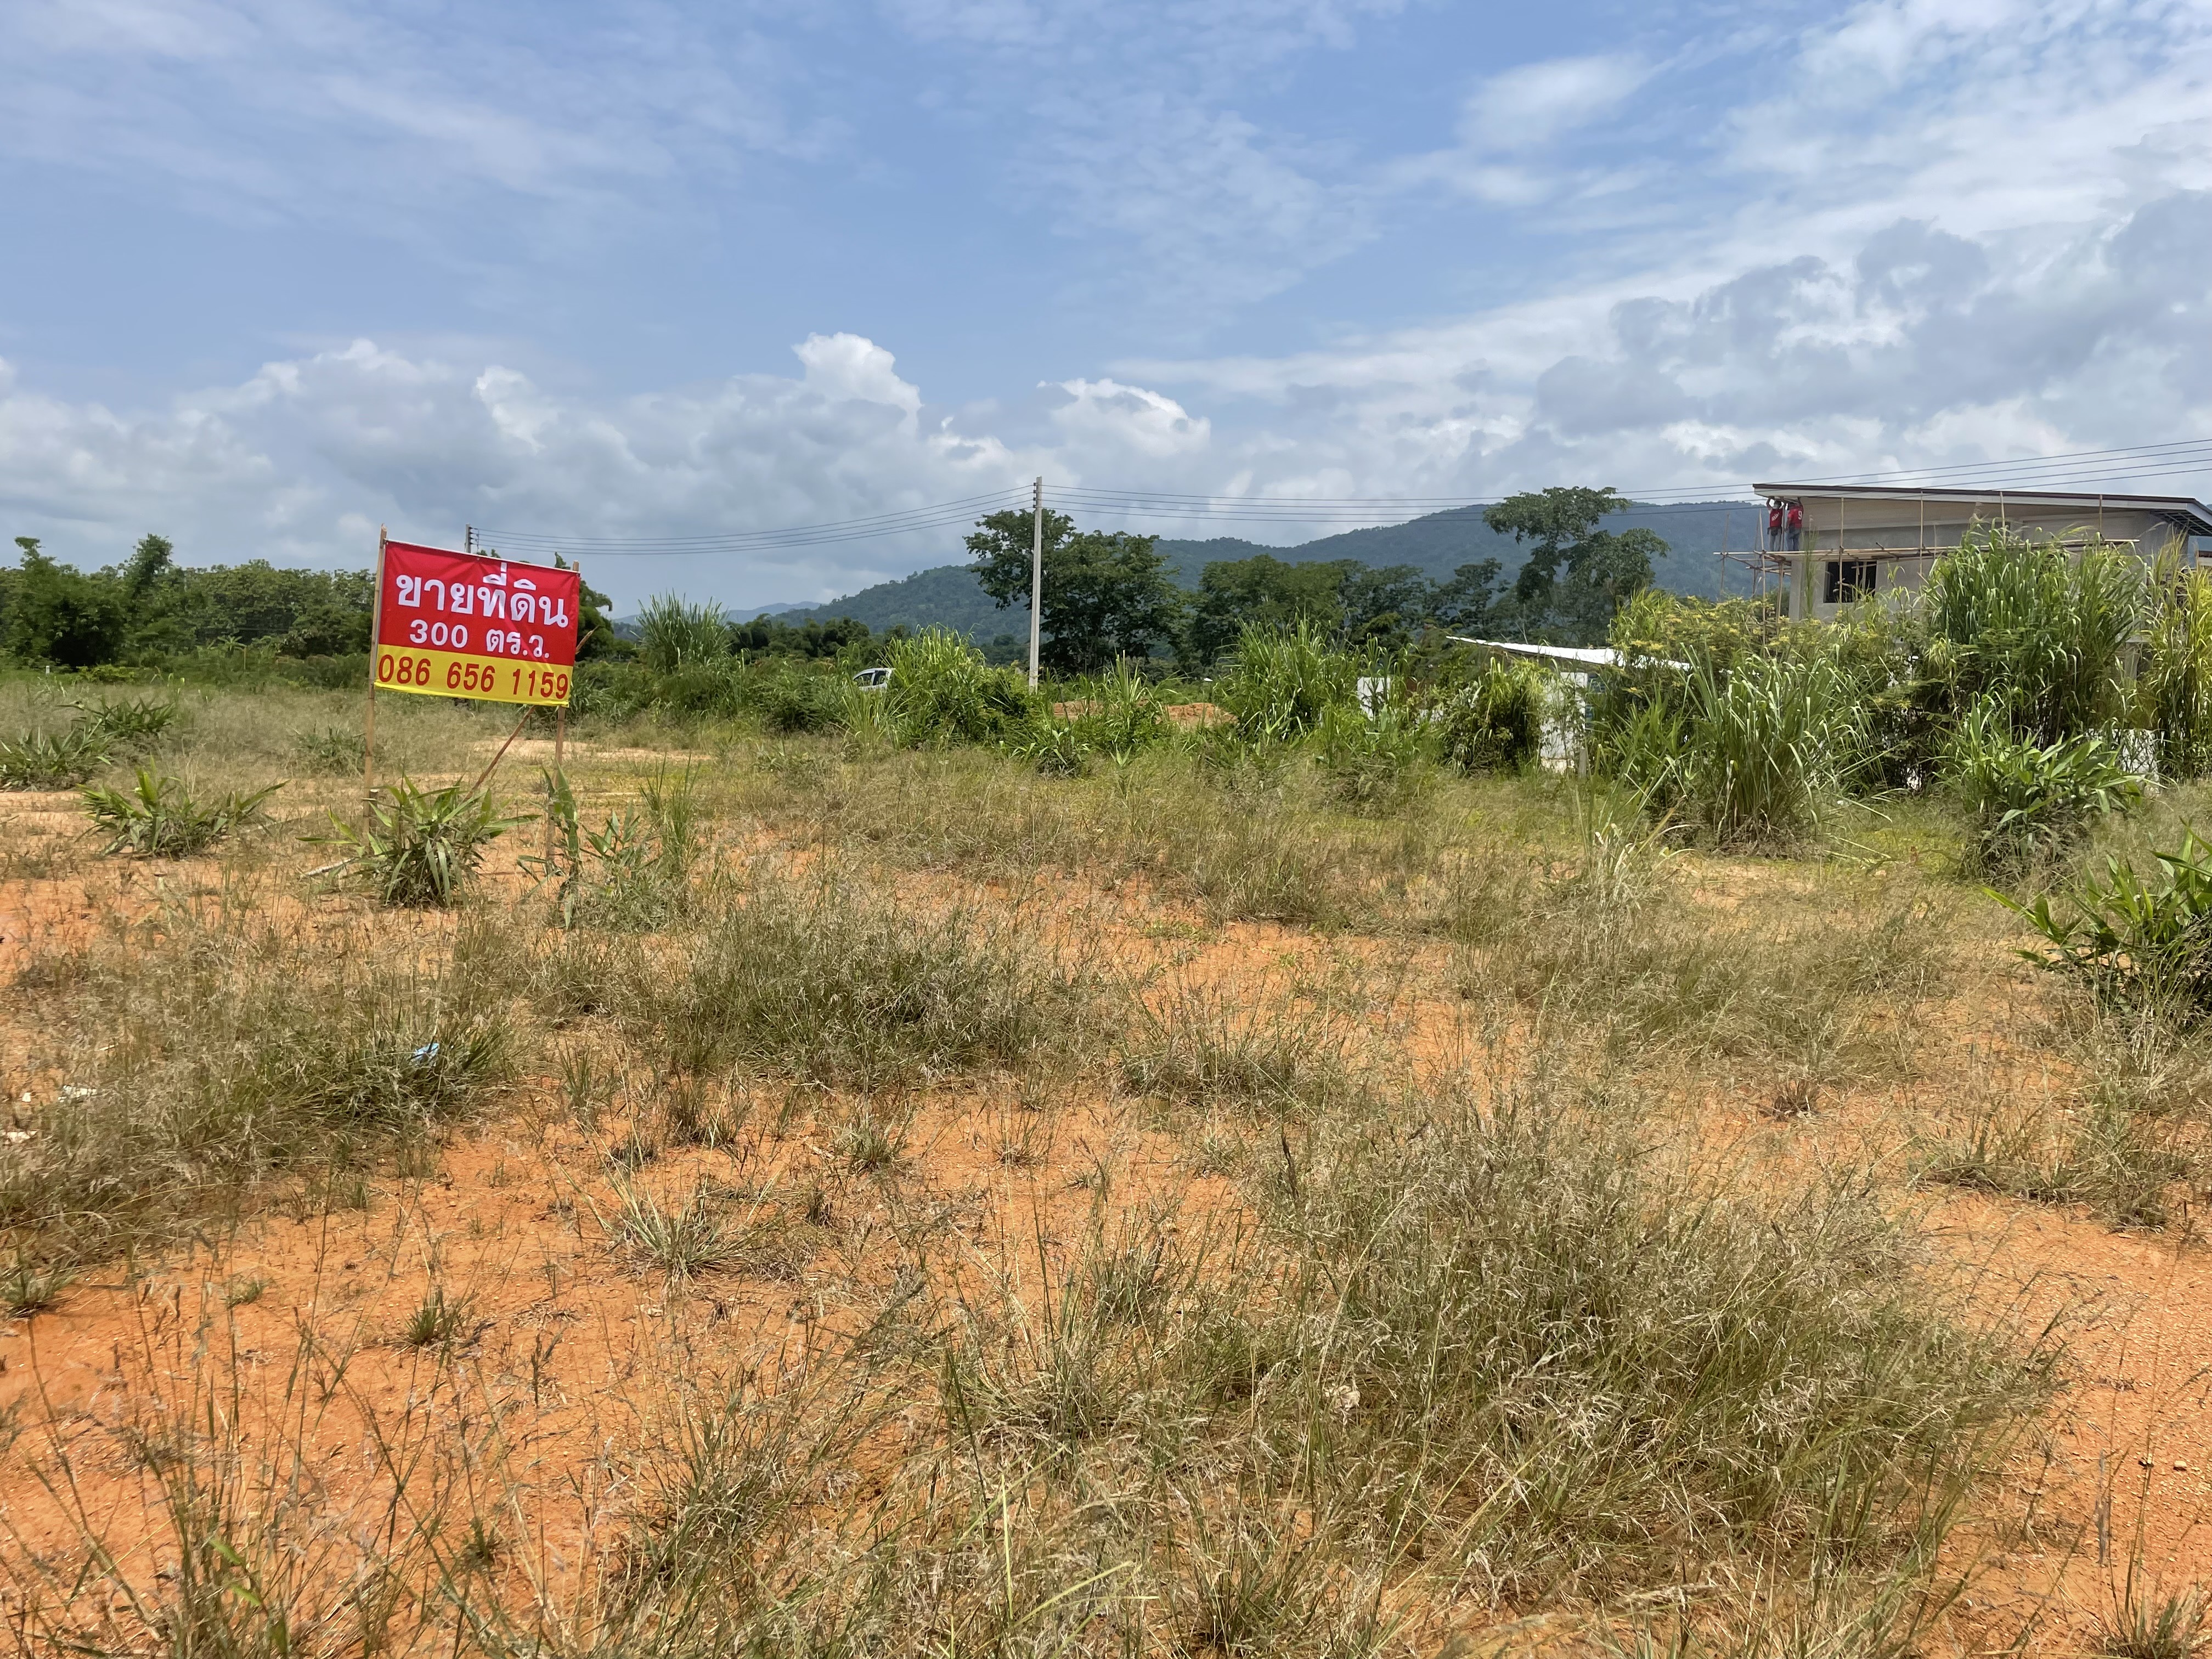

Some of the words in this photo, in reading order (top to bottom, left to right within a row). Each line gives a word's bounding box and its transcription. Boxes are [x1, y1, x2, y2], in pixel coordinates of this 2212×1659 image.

[396, 562, 568, 628] ขายที่ดิน
[410, 619, 468, 648] 300
[486, 629, 549, 658] ตร.ว.
[379, 654, 431, 685] 086
[447, 662, 495, 692] 656
[512, 669, 568, 699] 1159
